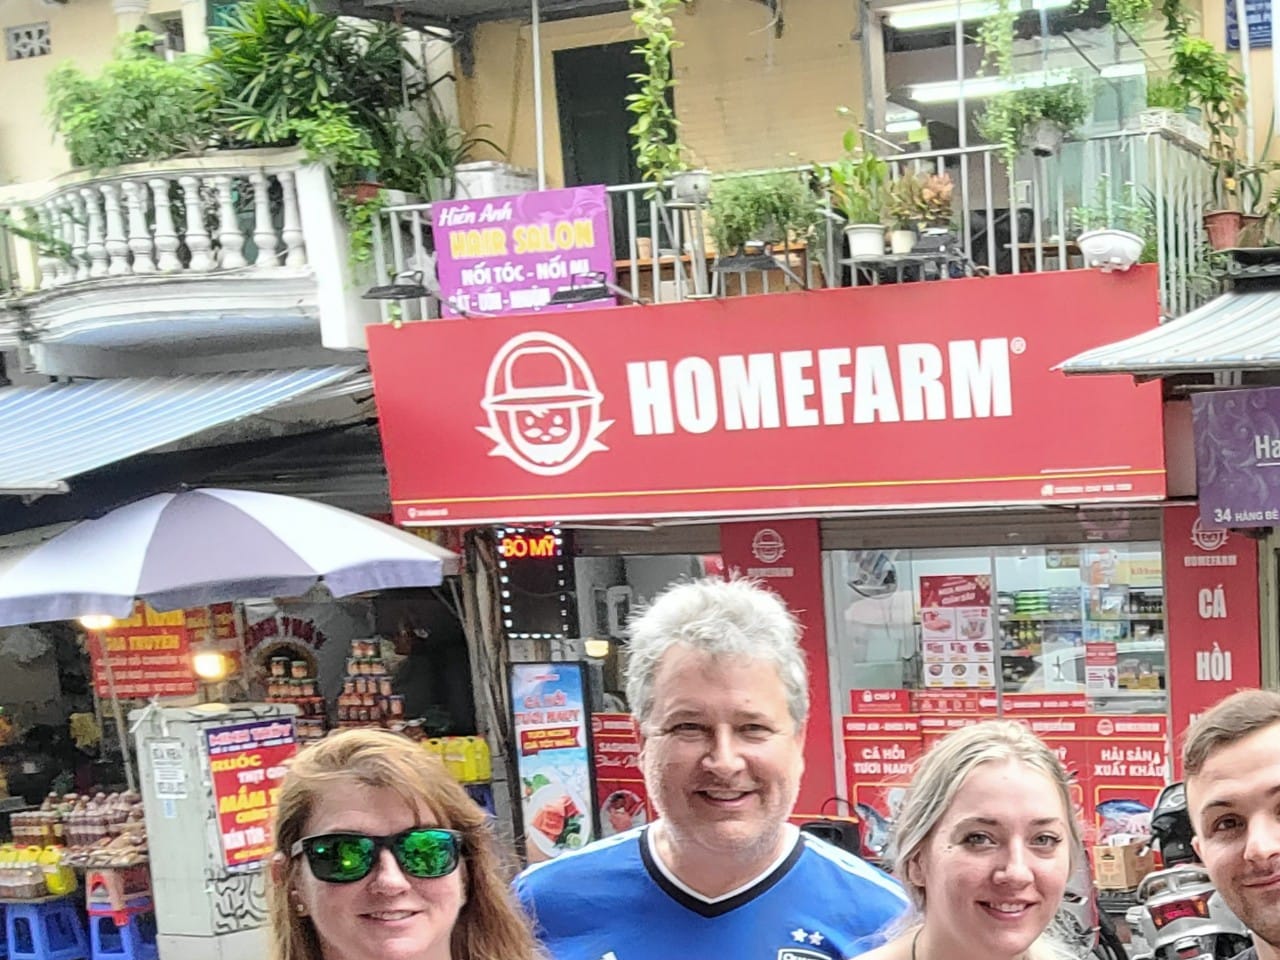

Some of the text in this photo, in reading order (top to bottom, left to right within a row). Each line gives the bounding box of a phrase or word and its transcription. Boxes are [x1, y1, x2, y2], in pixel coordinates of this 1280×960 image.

[449, 220, 595, 261] HAIR SALON
[626, 338, 1013, 436] HOMEFARM
[1214, 508, 1232, 522] 34
[503, 536, 528, 557] BÒ
[1198, 584, 1227, 618] CÁ
